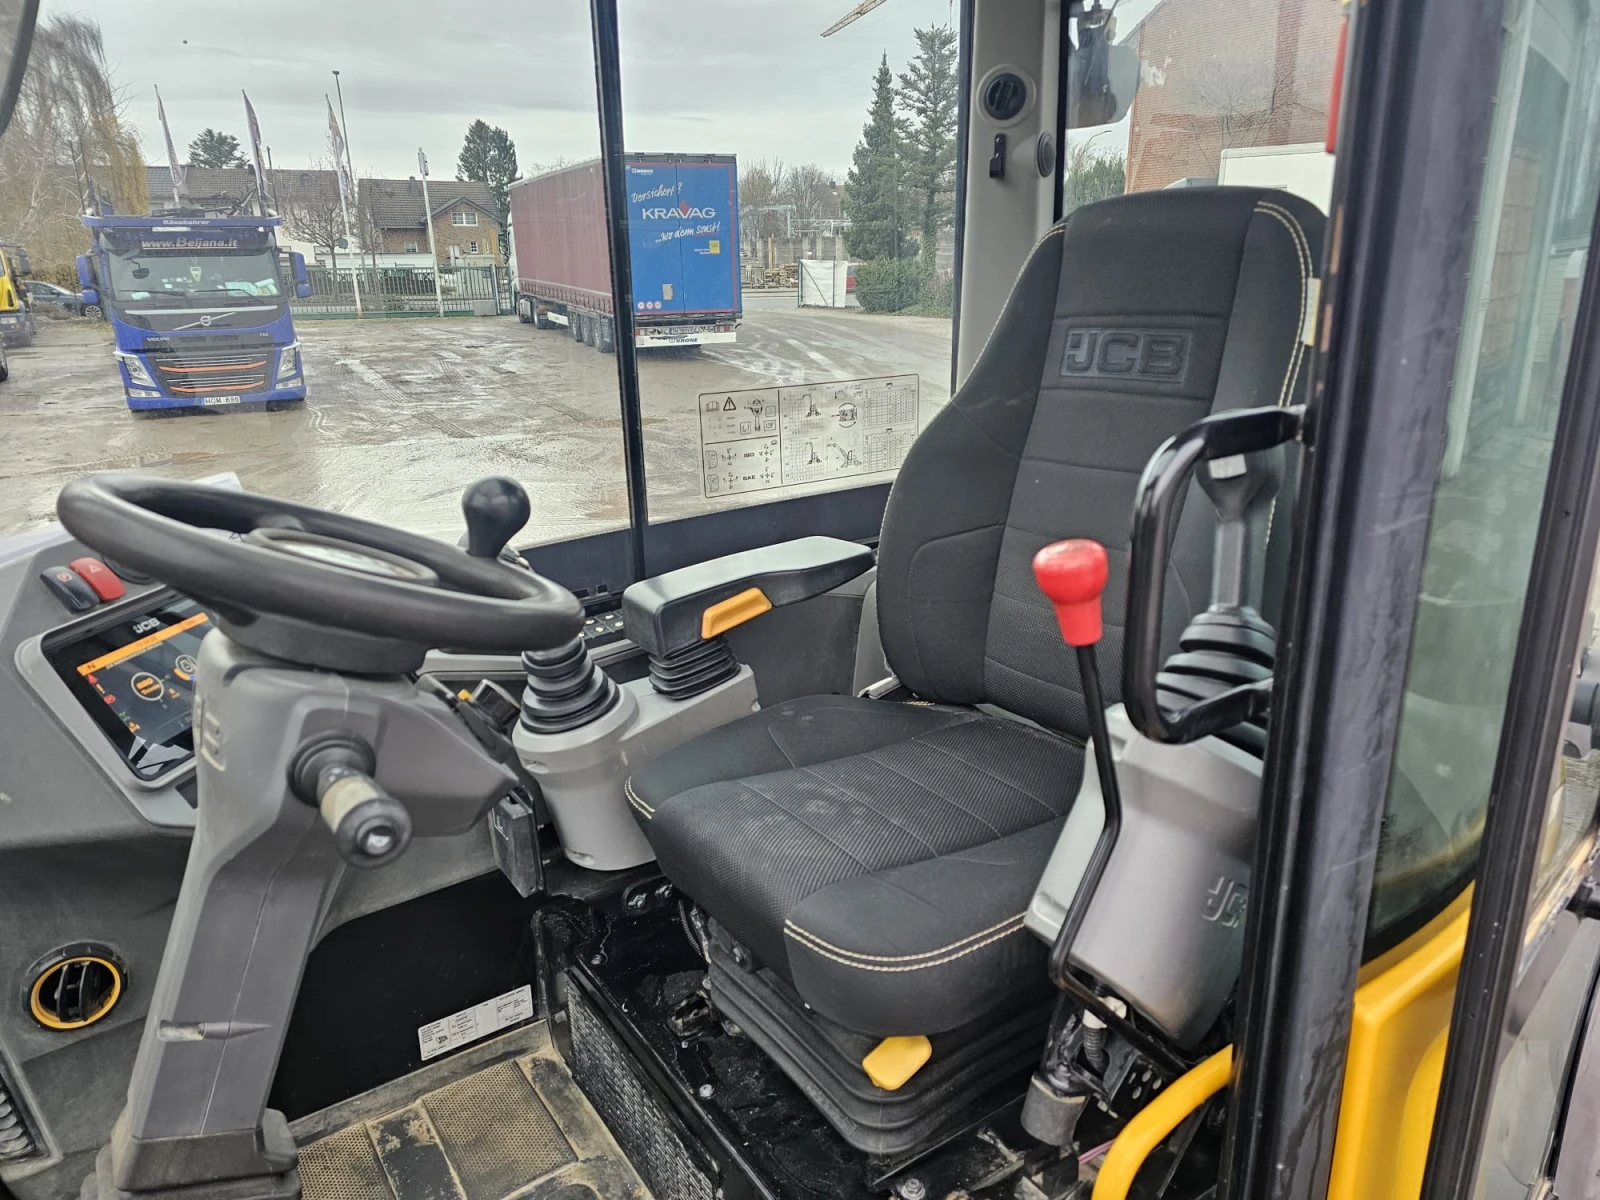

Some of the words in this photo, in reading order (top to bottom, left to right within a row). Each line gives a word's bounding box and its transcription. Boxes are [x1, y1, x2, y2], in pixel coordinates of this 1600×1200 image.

[642, 207, 716, 219] KRAVAG
[1065, 332, 1185, 375] JCB
[132, 617, 160, 634] JCB
